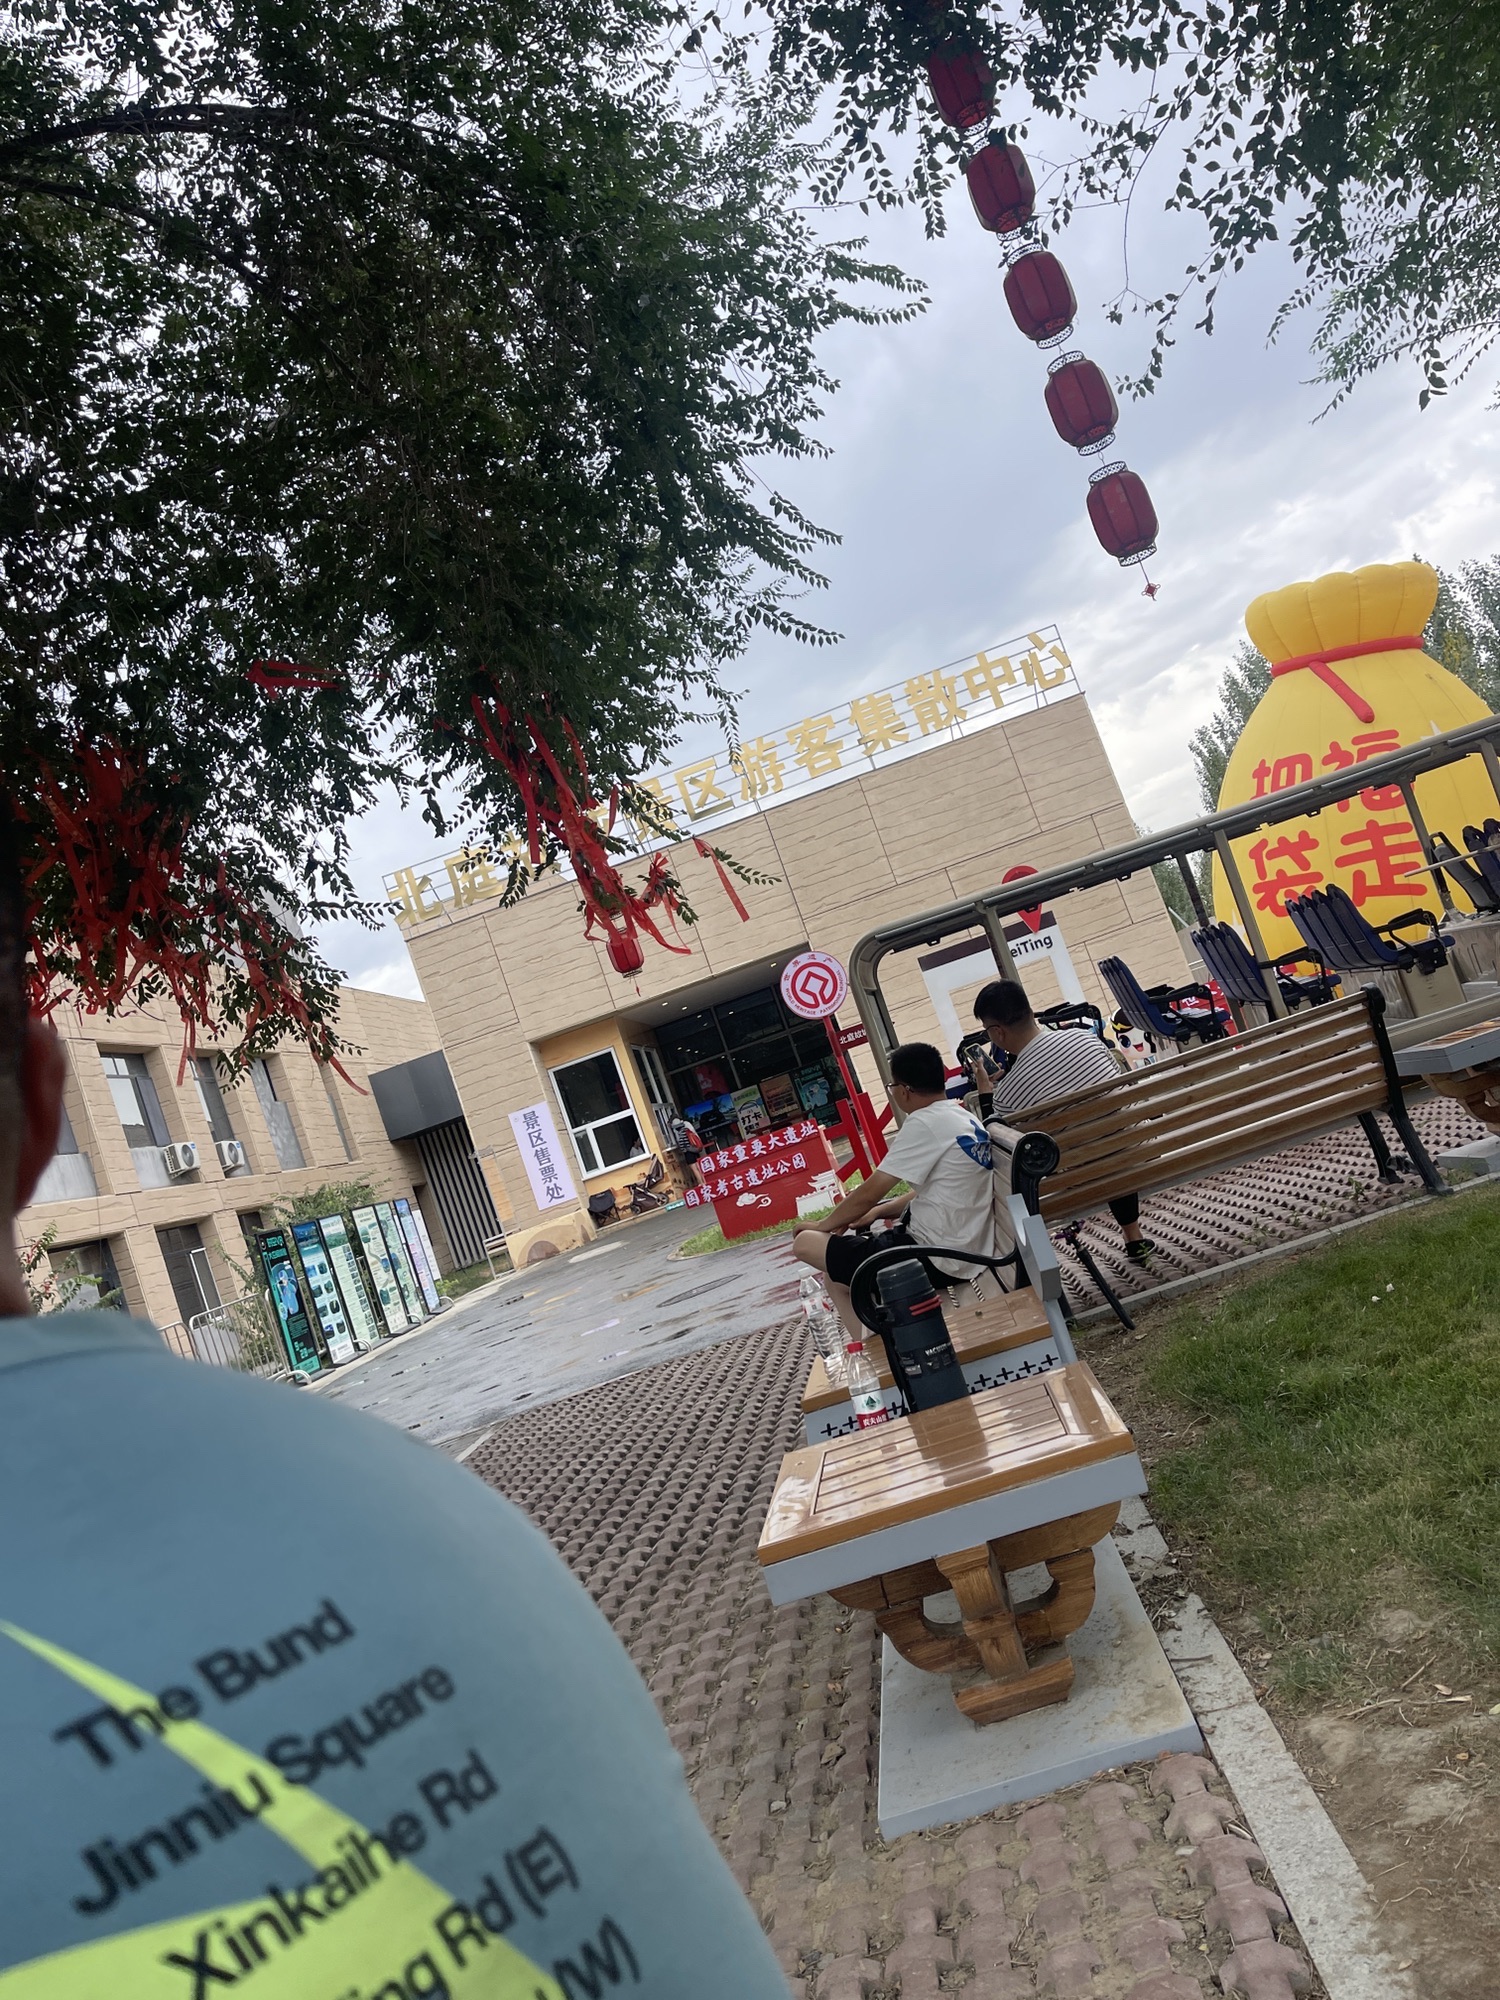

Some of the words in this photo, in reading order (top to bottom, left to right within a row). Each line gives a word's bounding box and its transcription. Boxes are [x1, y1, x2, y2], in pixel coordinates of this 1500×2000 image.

[387, 631, 1072, 926] 北庭景区游客集散中心
[1010, 935, 1053, 958] eiTing
[522, 1110, 565, 1203] 景区售票处
[53, 1685, 201, 1767] The
[195, 1597, 355, 1703] Bund
[75, 1770, 275, 1915] Jinniu
[265, 1667, 455, 1786] Square
[162, 1808, 428, 2000] Xinkaihe
[416, 1746, 499, 1829] Rd
[432, 1872, 516, 1968] Rd
[504, 1826, 581, 1919] (E)
[534, 1913, 642, 2000] W)
